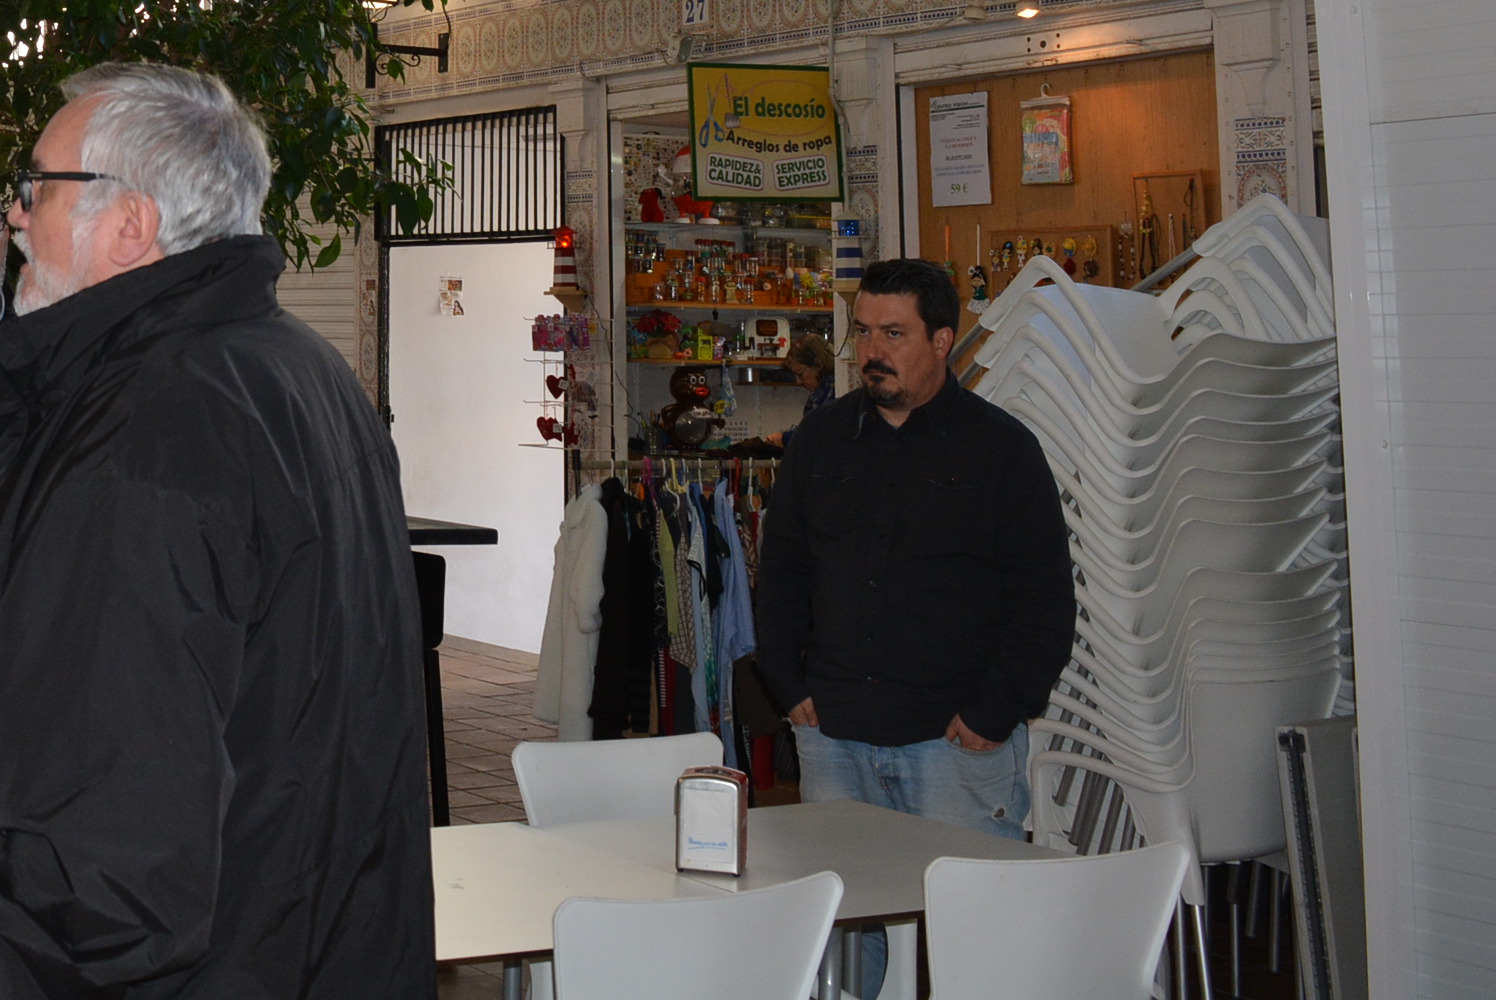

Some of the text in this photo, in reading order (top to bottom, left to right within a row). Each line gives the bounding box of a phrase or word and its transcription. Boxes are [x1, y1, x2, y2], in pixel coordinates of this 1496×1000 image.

[732, 95, 827, 119] El descosío
[725, 129, 833, 154] Arreglos de ropa
[709, 156, 762, 175] RAPIDEZ&
[775, 158, 825, 175] SERVICIO
[708, 168, 762, 188] CALIDAD
[777, 170, 827, 188] EXPRESS
[950, 183, 961, 194] 59
